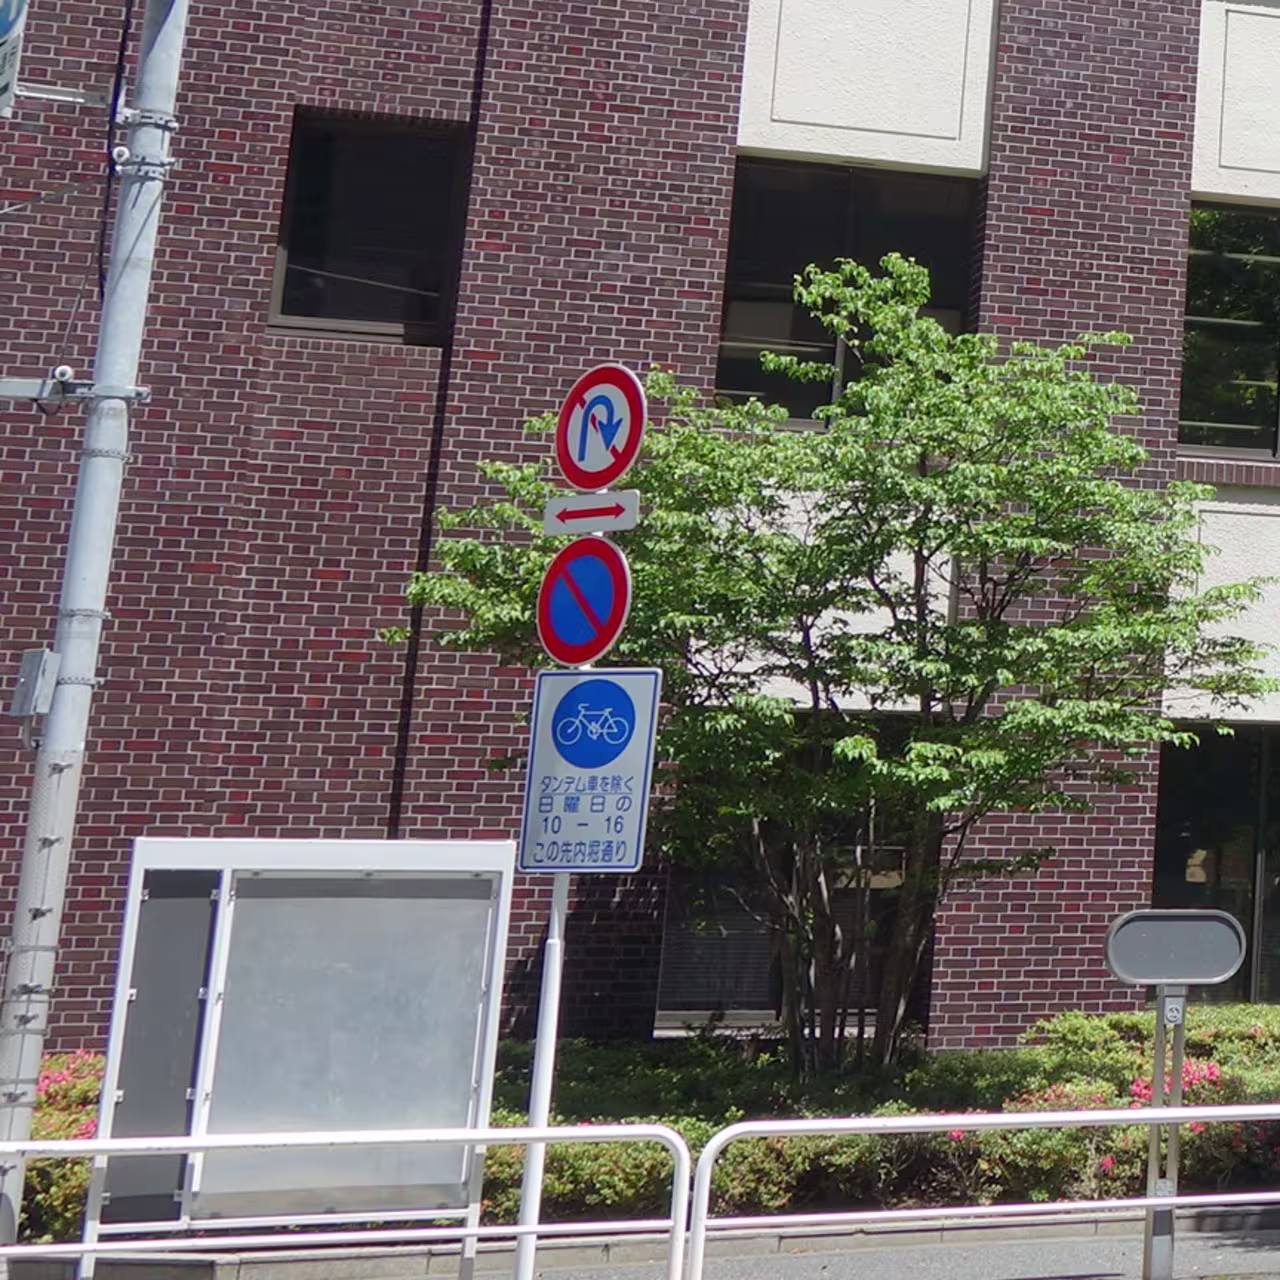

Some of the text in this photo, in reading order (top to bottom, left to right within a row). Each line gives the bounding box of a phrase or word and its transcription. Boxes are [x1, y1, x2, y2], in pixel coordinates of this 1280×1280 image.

[540, 775, 634, 792] タンデム車を除く
[533, 840, 627, 863] この先内堀通り
